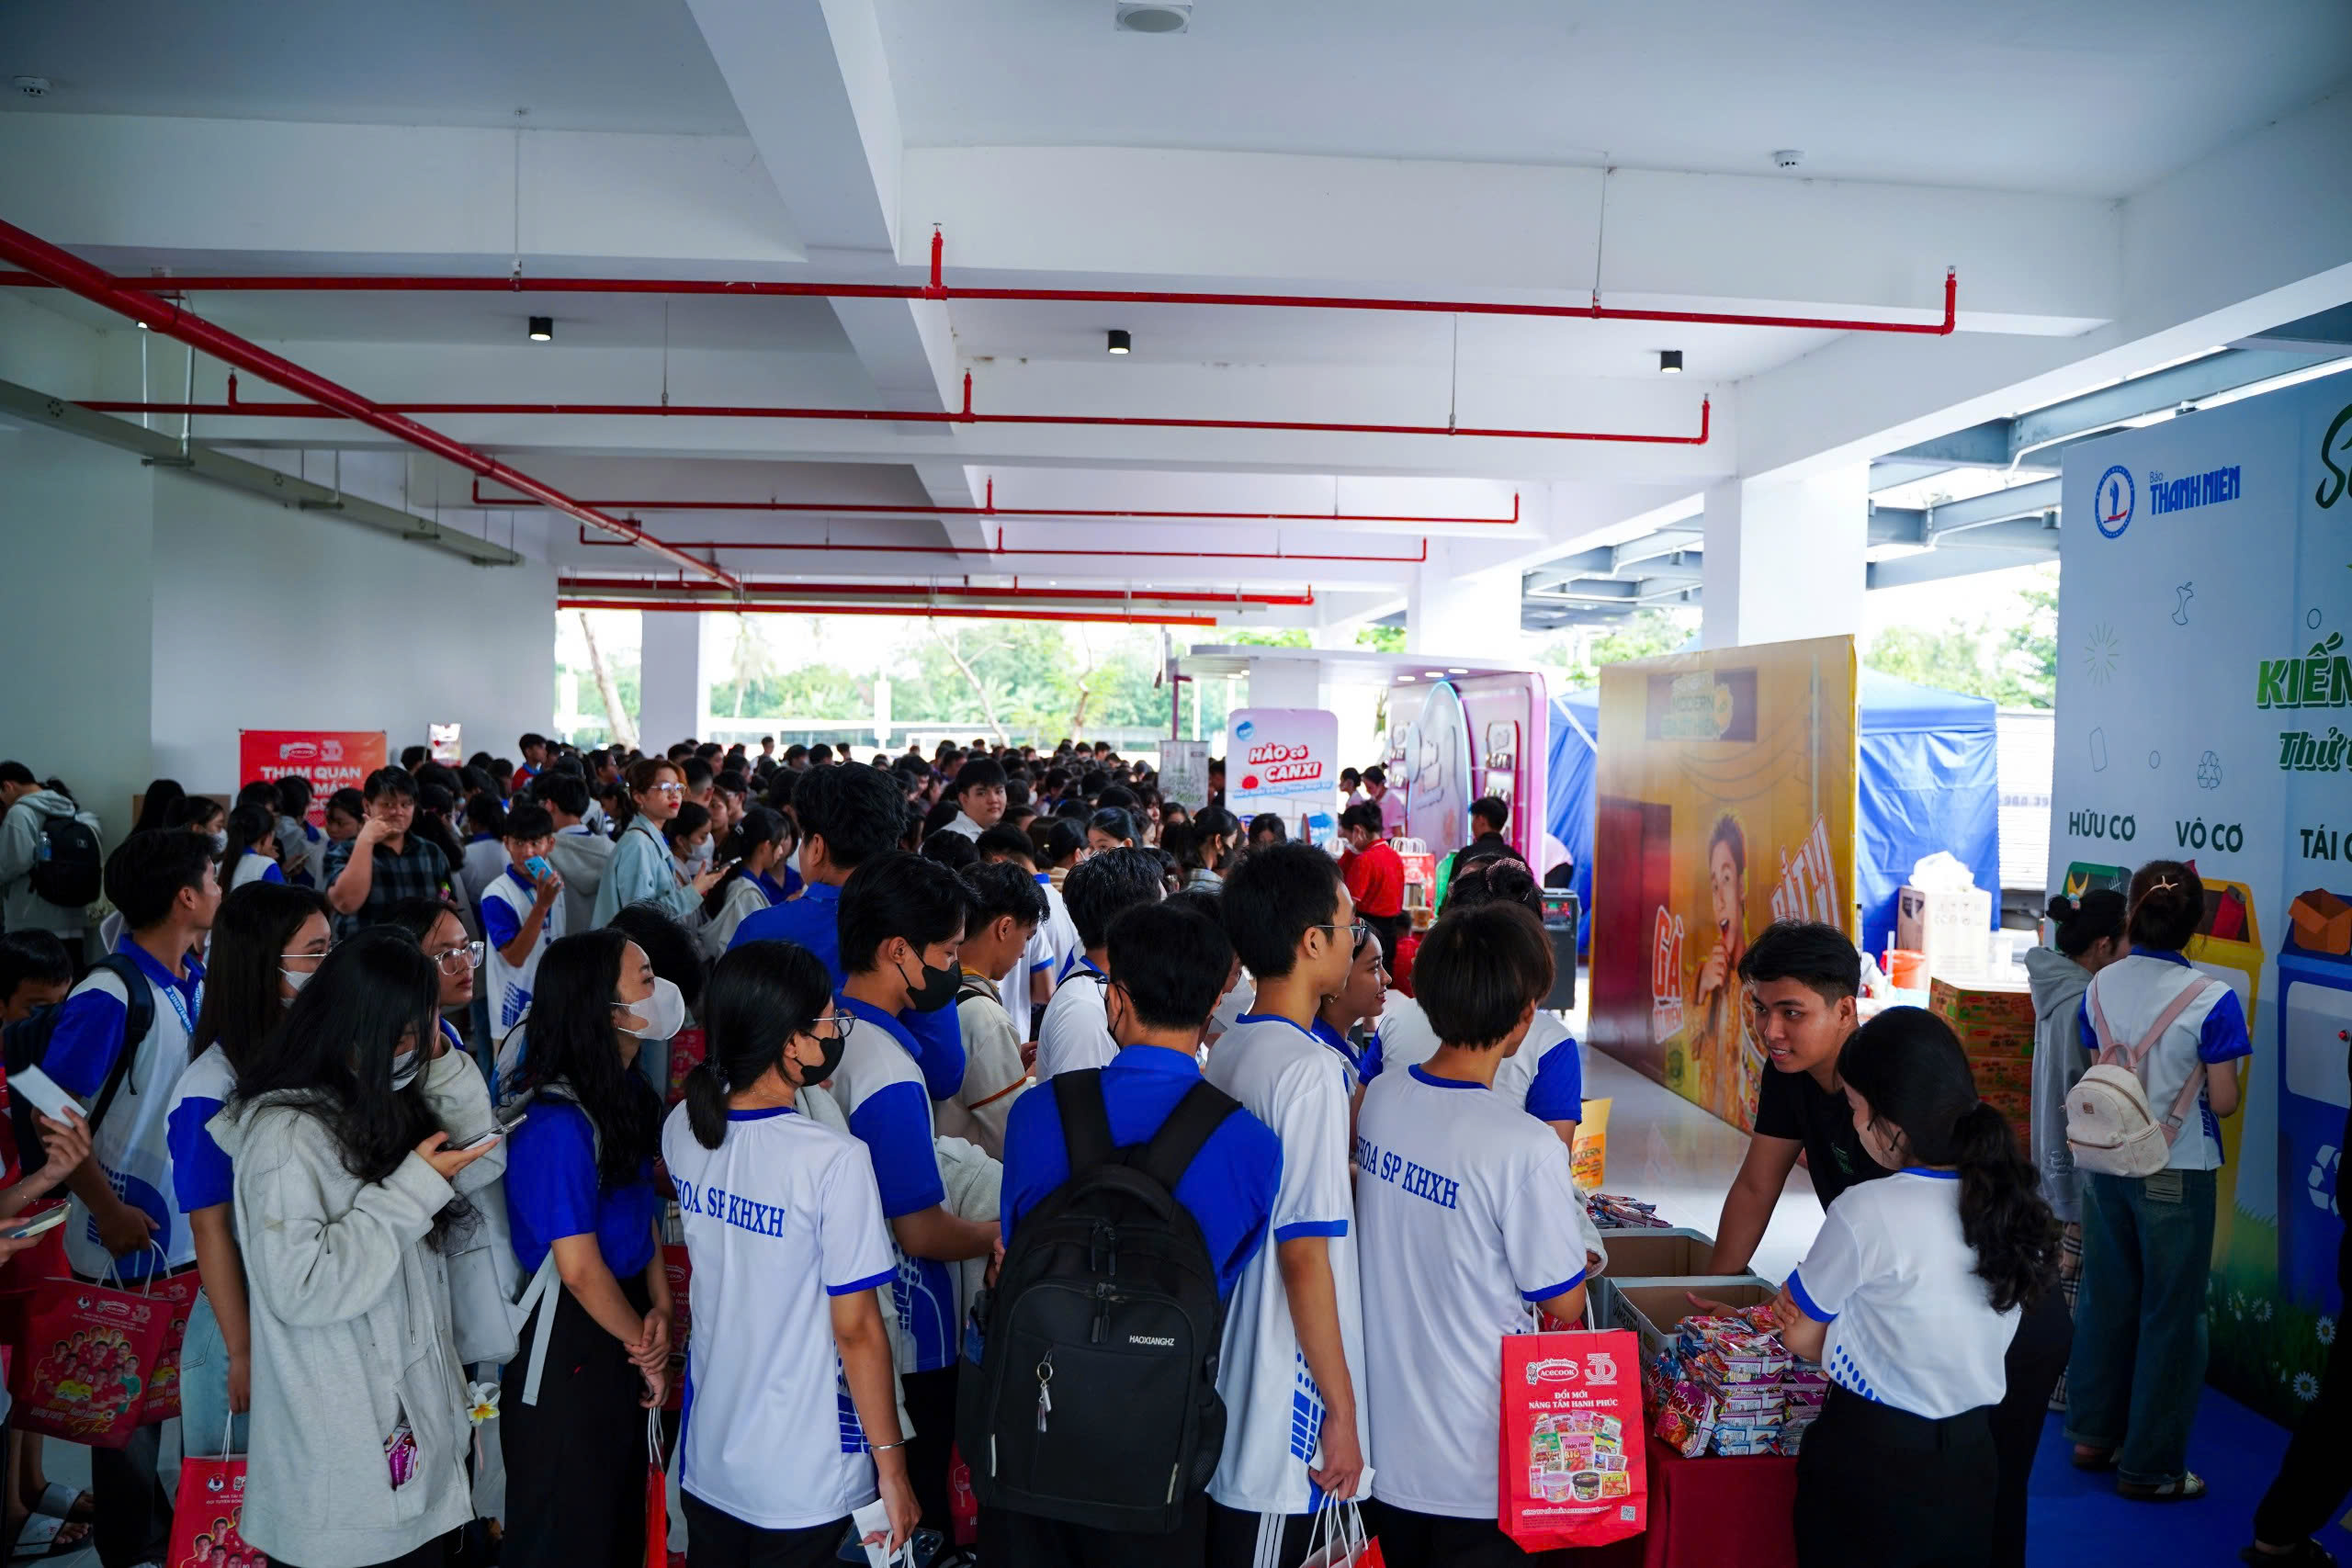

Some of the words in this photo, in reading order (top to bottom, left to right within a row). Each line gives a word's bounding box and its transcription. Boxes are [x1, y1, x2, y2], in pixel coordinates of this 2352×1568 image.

[2150, 470, 2164, 483] Báo
[2150, 475, 2201, 515] THANH
[2202, 465, 2242, 506] NIÊN
[1249, 742, 1288, 765] HẢO
[260, 766, 311, 780] THAM
[314, 766, 361, 780] QUAN
[1265, 761, 1323, 784] CANXI
[2068, 808, 2105, 839] HỮU
[2109, 814, 2136, 842] CƠ
[2176, 817, 2207, 850] VÔ
[2211, 823, 2244, 853] CƠ
[2300, 824, 2337, 862] TÁI
[1380, 1150, 1402, 1184] SP
[1401, 1160, 1460, 1210] KHXH
[707, 1186, 726, 1219] SP
[726, 1193, 786, 1238] KHXH
[1128, 1335, 1175, 1347] HAOXIANGHZ
[1529, 1400, 1551, 1409] NÂNG
[1596, 1398, 1618, 1407] PHÚC
[1554, 1388, 1570, 1400] ĐỔI
[1572, 1389, 1588, 1399] MỚI
